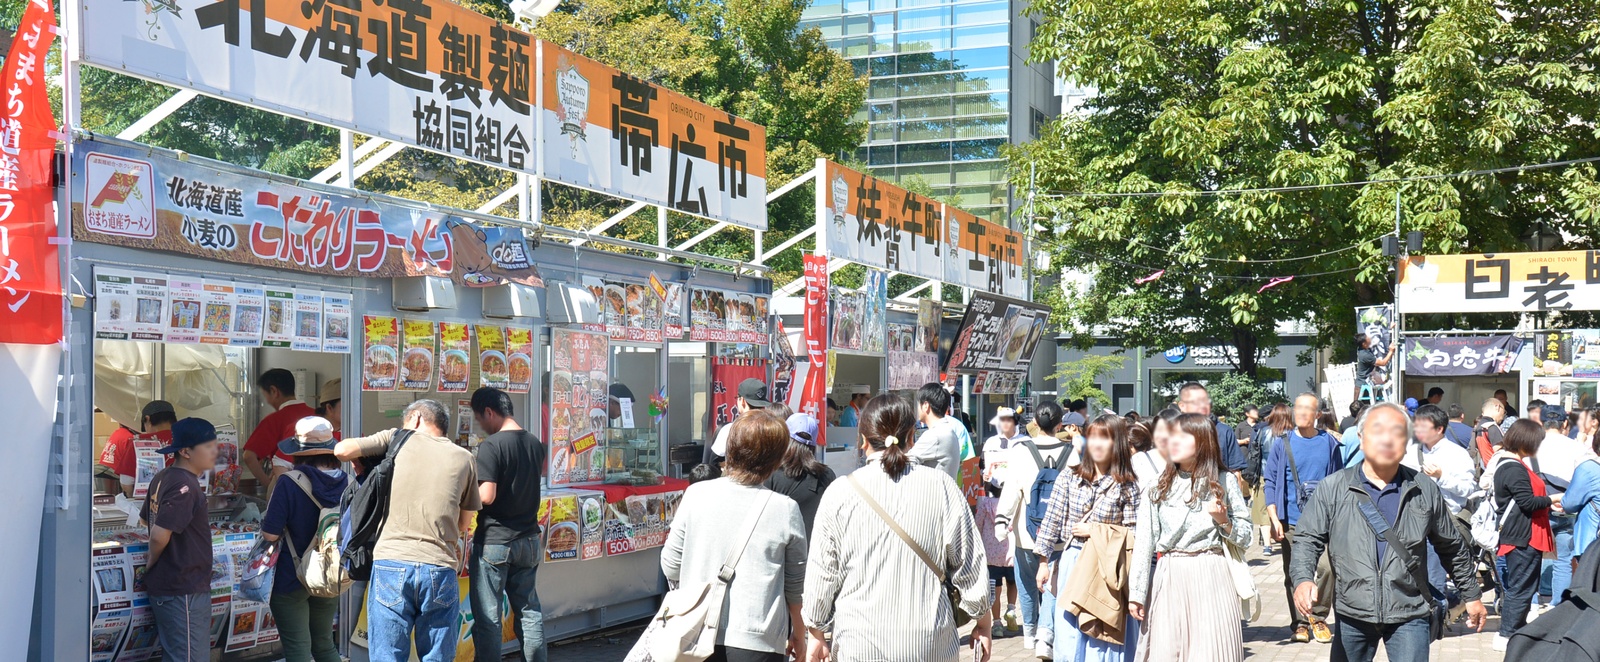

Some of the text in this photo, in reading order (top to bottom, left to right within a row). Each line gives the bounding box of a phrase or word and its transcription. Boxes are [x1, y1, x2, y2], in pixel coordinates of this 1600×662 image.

[195, 0, 530, 116] 北海道製麺
[670, 101, 706, 123] OBIHIRO CITY
[413, 96, 530, 170] 協同組合
[612, 72, 749, 217] 帯広市
[166, 176, 244, 218] 北海道産
[88, 208, 152, 233] おまち道産ラーメン
[182, 215, 236, 249] 小麦の
[249, 191, 454, 274] こだわりラーメン
[1424, 345, 1507, 369] 白老牛
[1547, 333, 1559, 361] 白老牛
